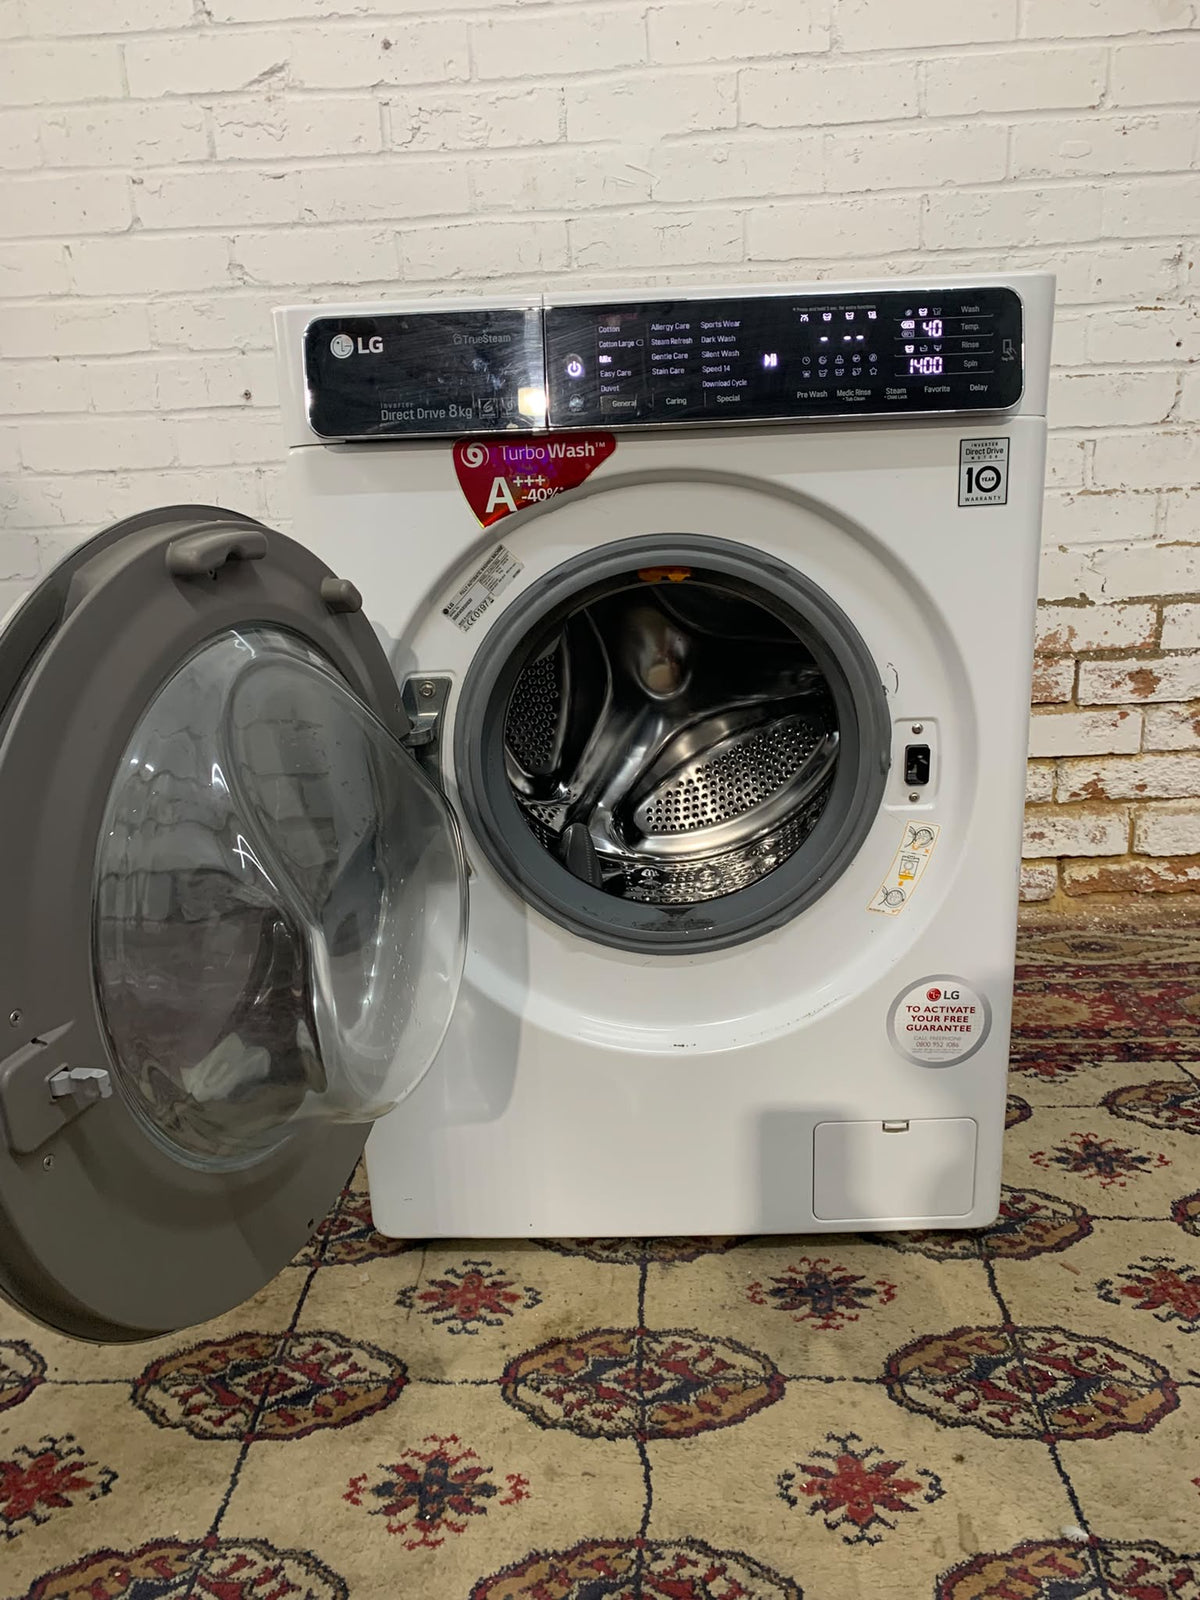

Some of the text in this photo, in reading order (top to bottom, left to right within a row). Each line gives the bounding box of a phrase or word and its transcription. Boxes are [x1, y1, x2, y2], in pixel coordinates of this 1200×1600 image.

[651, 323, 673, 332] Allergy
[700, 321, 721, 329] Sports
[923, 320, 942, 337] 40
[961, 323, 979, 332] Temp.
[463, 334, 511, 344] TrueSteam
[701, 335, 716, 343] Dark
[358, 337, 383, 353] LG
[618, 340, 634, 348] Large
[599, 355, 612, 363] Mix
[909, 357, 943, 374] 1400
[964, 360, 977, 368] Spin
[652, 367, 668, 375] Stain
[702, 365, 722, 373] Speed
[733, 379, 747, 387] Cycle
[886, 387, 906, 395] Steam
[924, 385, 950, 393] Favorite
[970, 383, 987, 392] Delay
[837, 389, 854, 397] Medic
[666, 397, 687, 405] Caring
[717, 394, 740, 402] Special
[612, 399, 637, 407] General
[381, 408, 414, 420] Direct
[417, 407, 445, 419] Drive
[966, 466, 1001, 493] 10
[474, 600, 489, 618] 0197
[944, 991, 959, 999] LG
